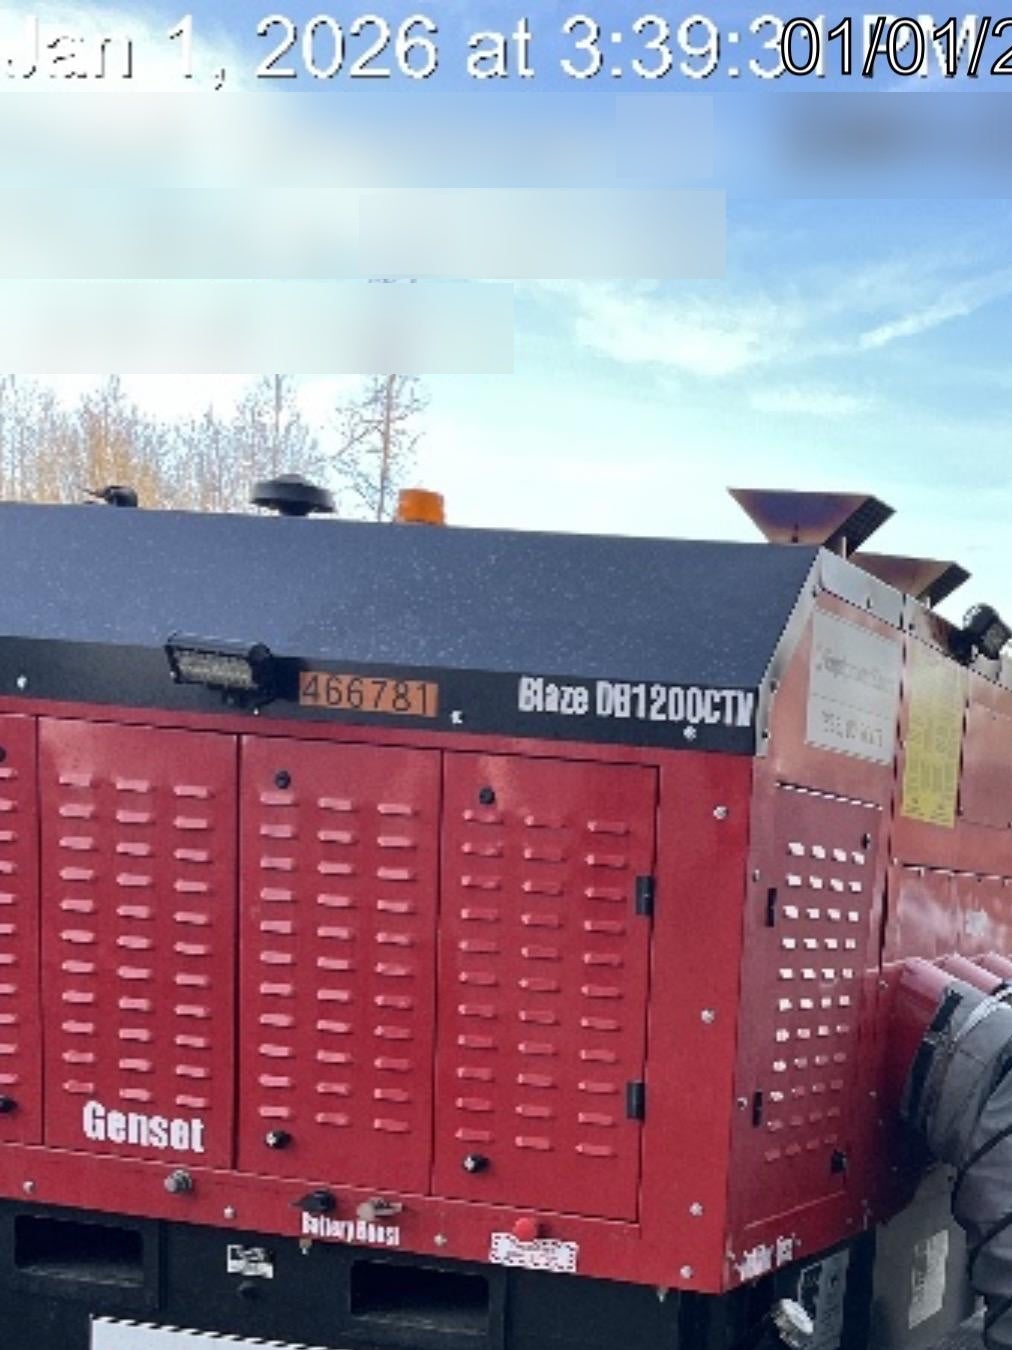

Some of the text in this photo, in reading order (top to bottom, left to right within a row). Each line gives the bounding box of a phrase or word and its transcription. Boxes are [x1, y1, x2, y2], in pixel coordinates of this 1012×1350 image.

[302, 674, 427, 716] 466781
[518, 676, 589, 716] Blaze
[82, 1100, 205, 1153] Genset
